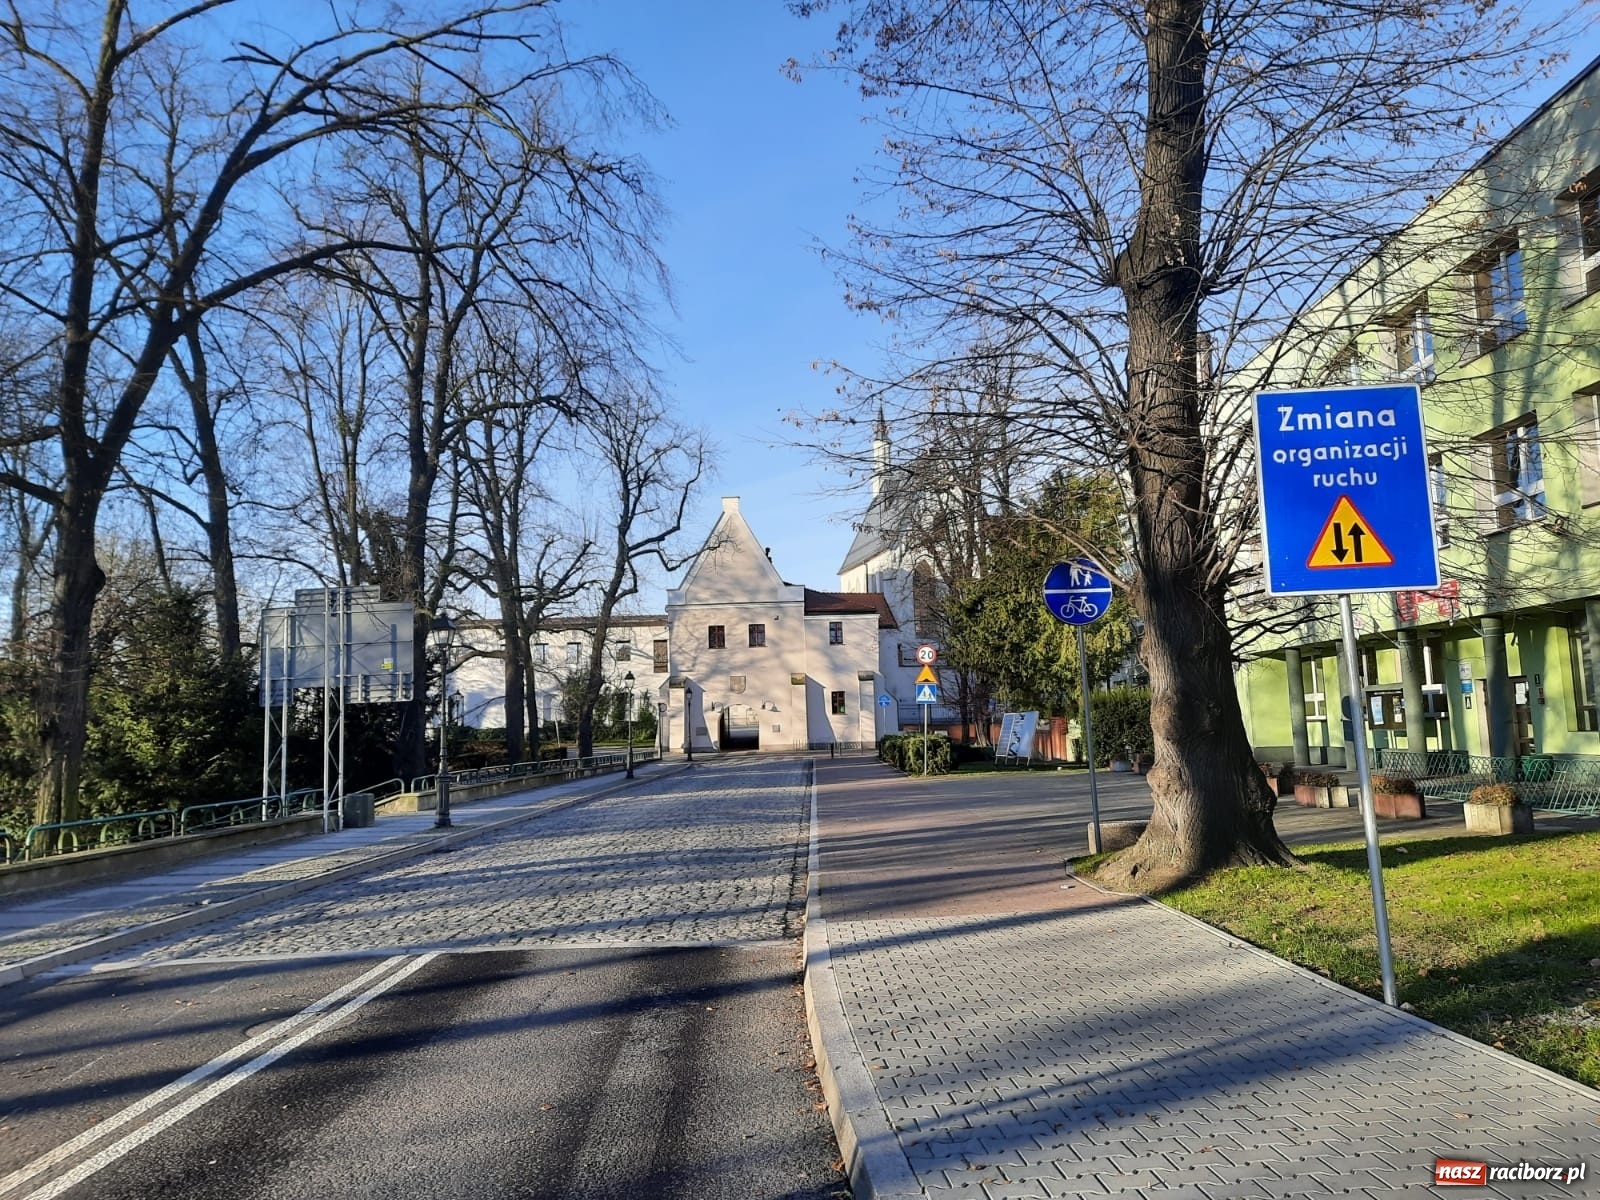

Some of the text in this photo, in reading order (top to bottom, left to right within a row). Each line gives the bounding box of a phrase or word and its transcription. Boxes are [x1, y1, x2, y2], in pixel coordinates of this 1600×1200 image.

[1277, 404, 1396, 432] Zmiana
[1272, 436, 1408, 467] organizacji
[1312, 467, 1378, 488] ruchu
[920, 650, 934, 660] 20
